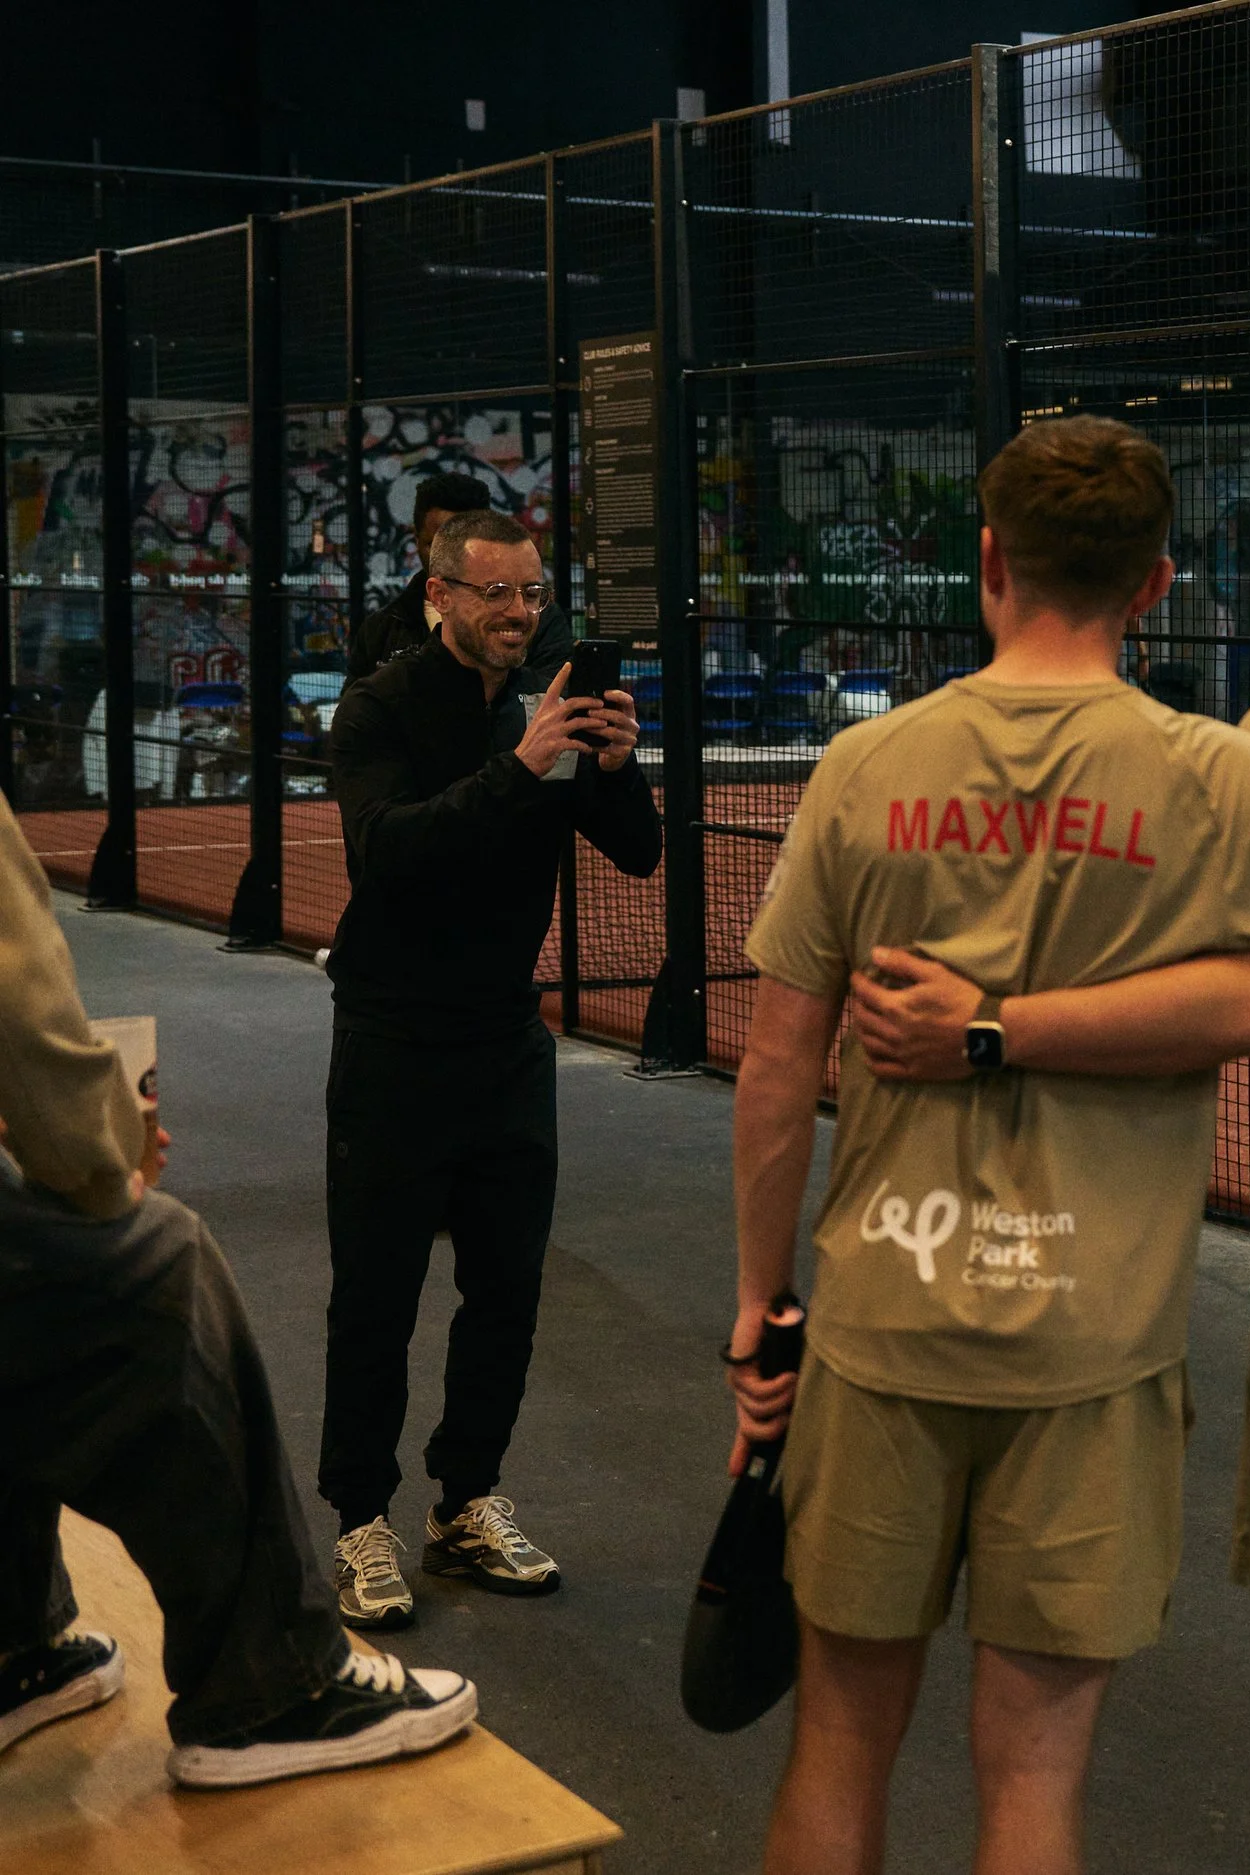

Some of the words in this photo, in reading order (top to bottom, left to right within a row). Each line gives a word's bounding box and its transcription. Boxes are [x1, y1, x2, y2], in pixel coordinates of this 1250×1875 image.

[886, 795, 1157, 869] MAXWELL
[970, 1200, 1077, 1238] Weston
[967, 1235, 1040, 1269] Park
